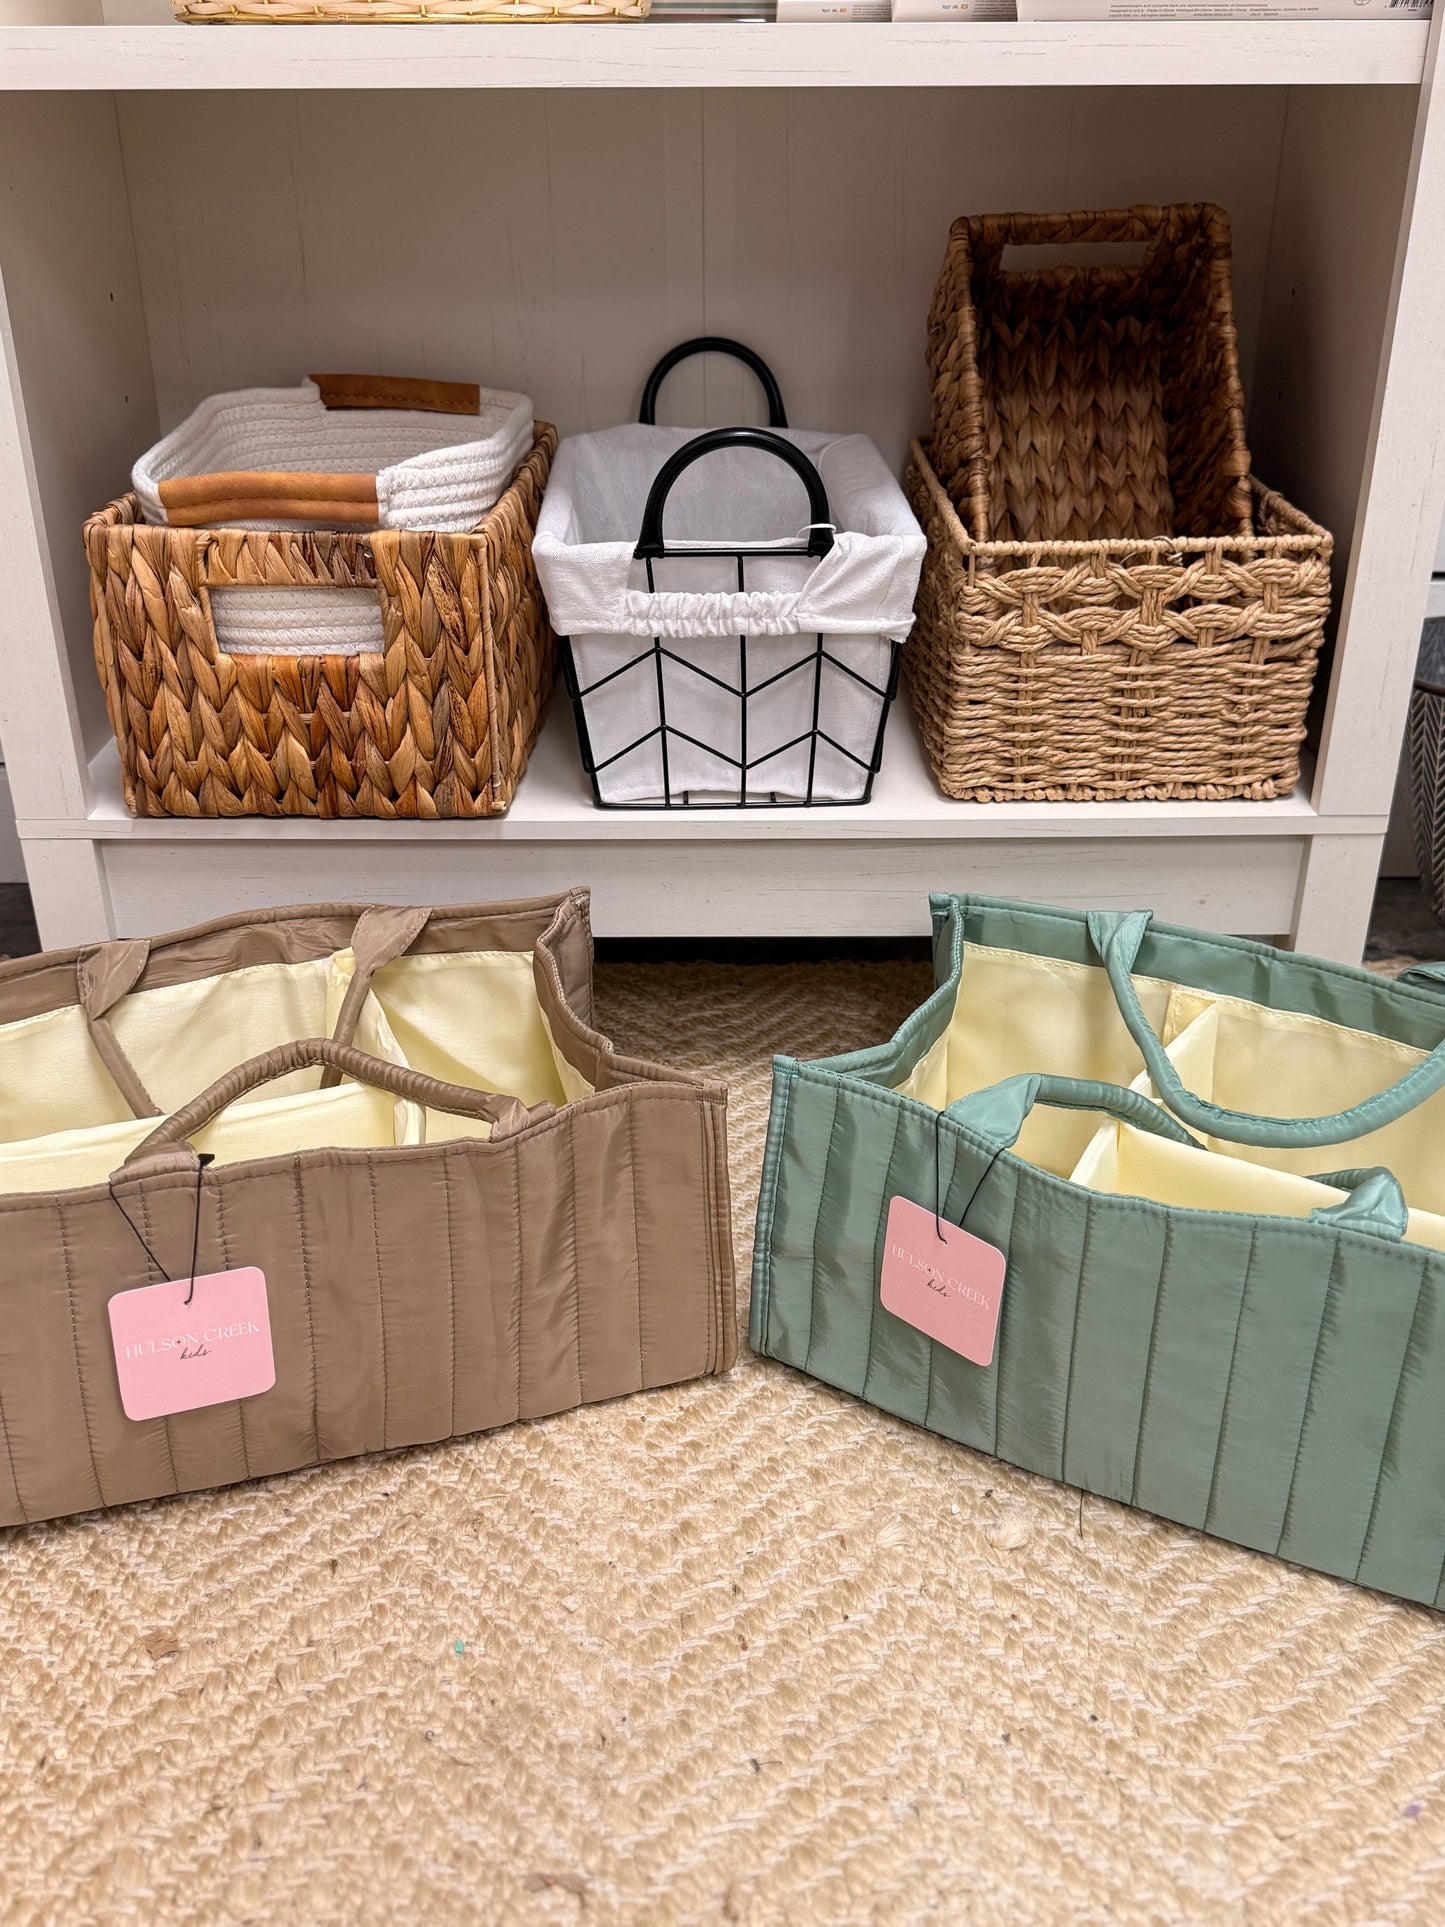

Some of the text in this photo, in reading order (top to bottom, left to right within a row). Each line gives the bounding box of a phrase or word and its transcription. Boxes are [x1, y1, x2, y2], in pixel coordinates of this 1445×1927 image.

[892, 1243, 991, 1310] HULSON CREEK
[126, 1320, 260, 1359] HULSON CREEK
[180, 1344, 211, 1360] kids
